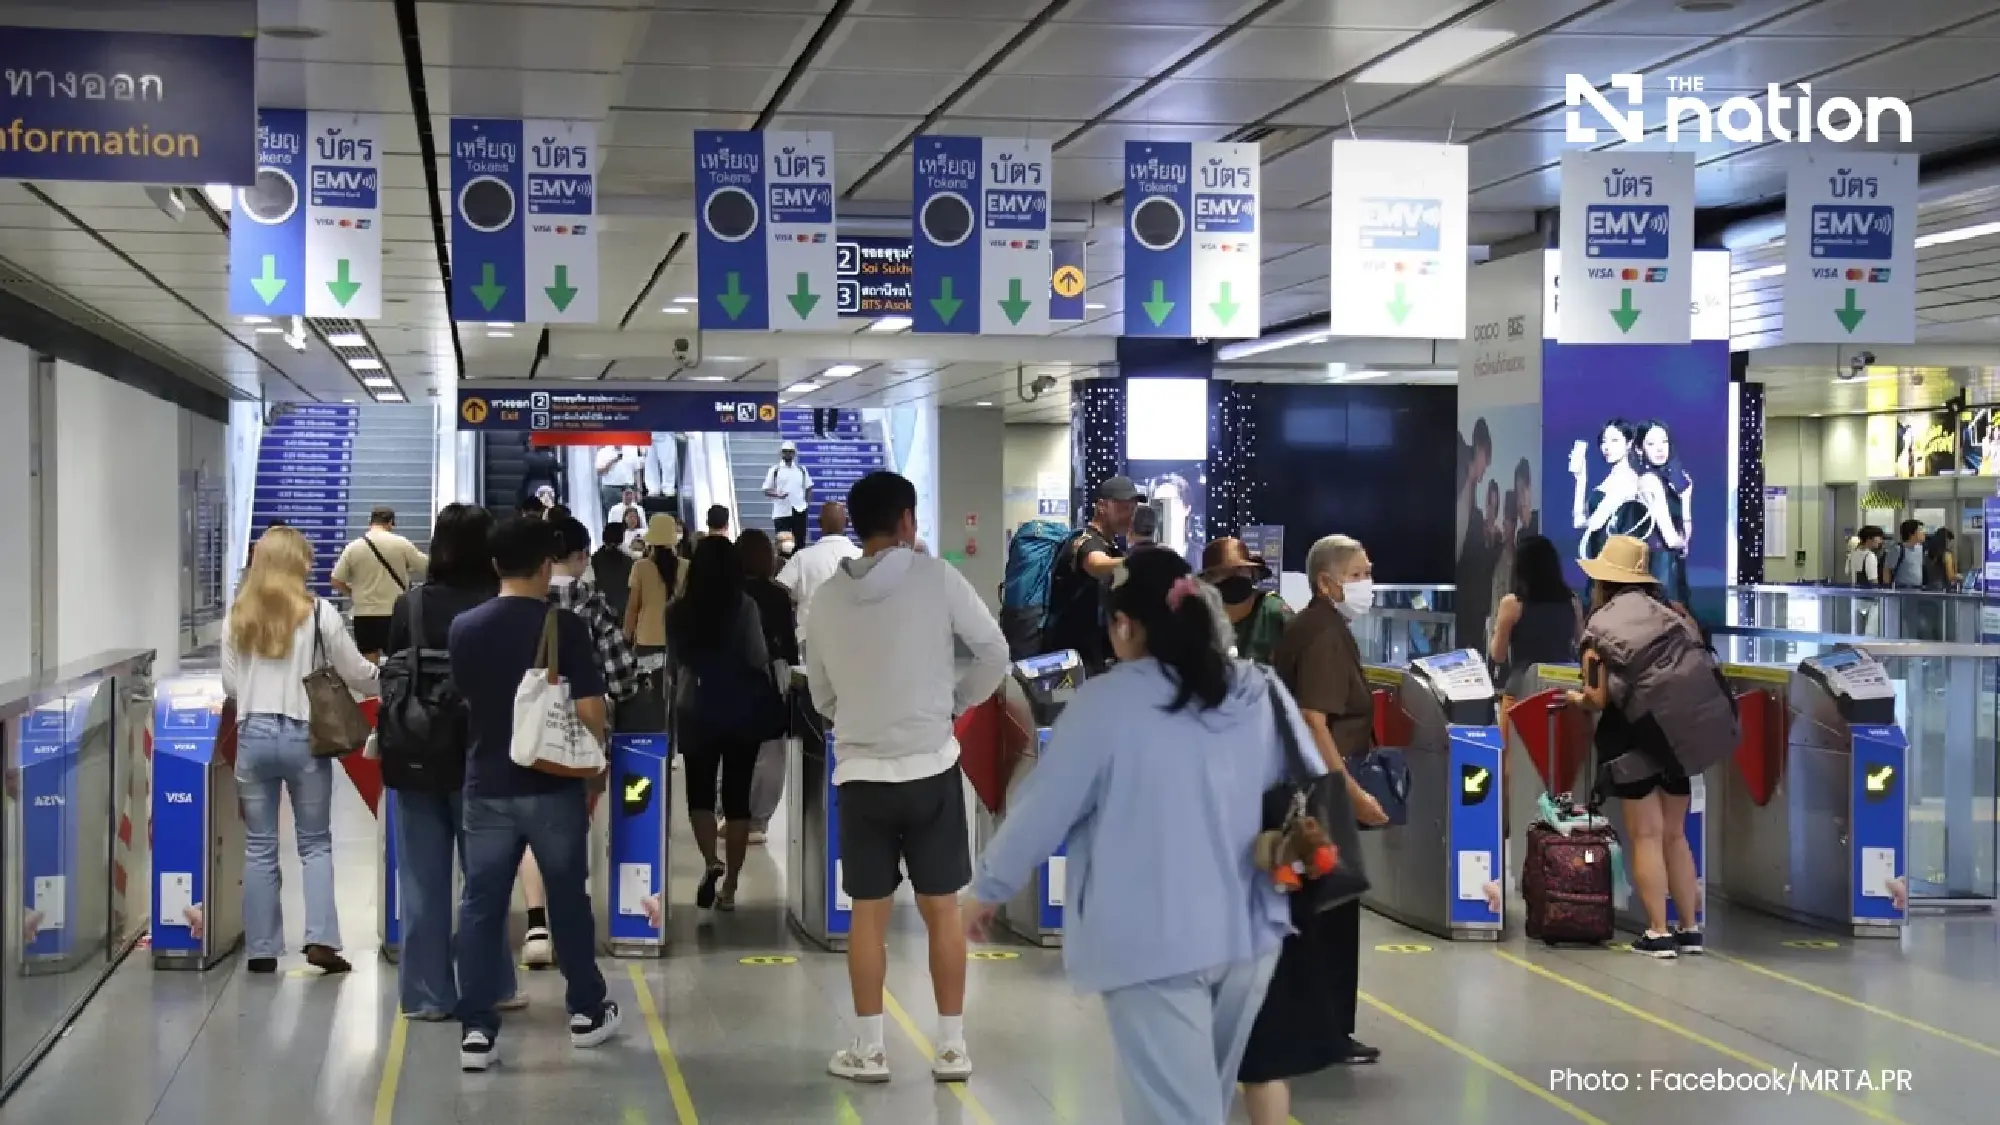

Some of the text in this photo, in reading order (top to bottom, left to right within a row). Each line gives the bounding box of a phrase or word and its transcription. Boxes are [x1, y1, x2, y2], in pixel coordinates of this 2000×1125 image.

[5, 68, 163, 101] ทางออก
[316, 128, 372, 161] บัตร
[532, 137, 586, 168] บัตร
[774, 147, 826, 177] บัตร
[991, 154, 1042, 184] บัตร
[313, 171, 362, 189] EMV
[1201, 159, 1252, 188] บัตร
[1603, 168, 1653, 197] บัตร
[1829, 168, 1879, 199] บัตร
[530, 179, 577, 196] EMV
[771, 188, 817, 206] EMV
[987, 194, 1032, 212] EMV
[1197, 199, 1241, 216] EMV
[1588, 211, 1650, 235] EMV
[1813, 211, 1875, 235] EMV
[838, 250, 851, 268] 2
[1812, 268, 1839, 279] VISA
[838, 287, 851, 305] 3
[536, 396, 546, 408] 2
[165, 793, 192, 803] VISA
